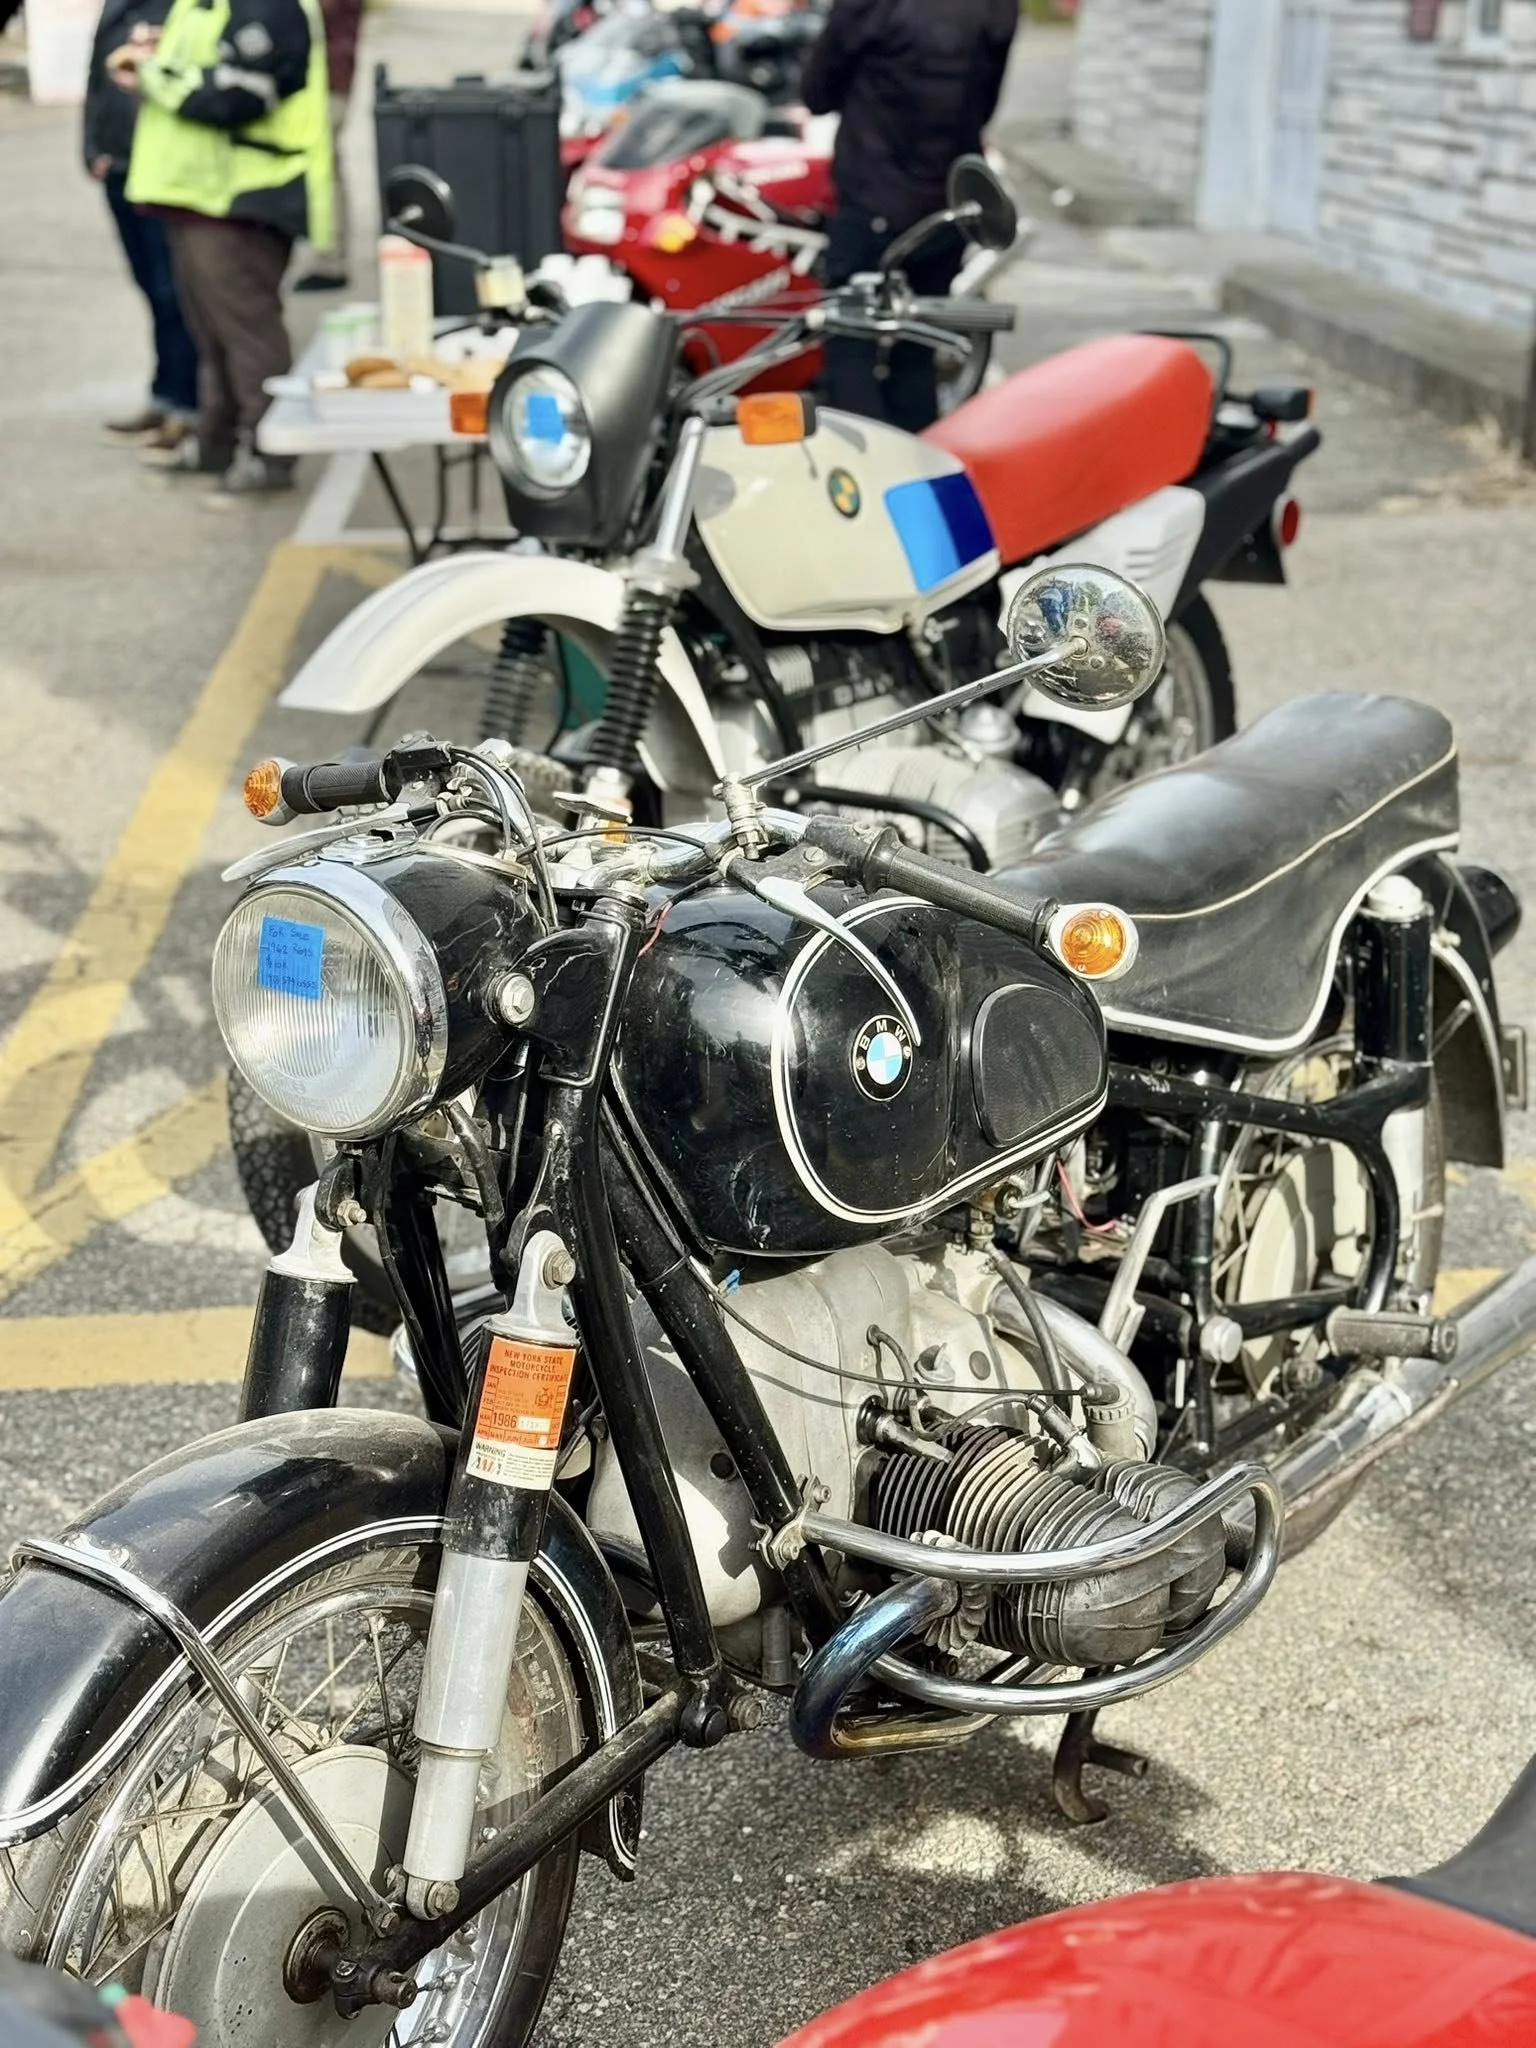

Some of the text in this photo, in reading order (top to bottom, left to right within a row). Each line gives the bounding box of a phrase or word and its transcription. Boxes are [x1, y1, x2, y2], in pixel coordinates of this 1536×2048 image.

[267, 941, 288, 955] 1962
[858, 1019, 907, 1051] BMW
[504, 1349, 564, 1365] NEW YORK STATE
[490, 1364, 530, 1379] INSPECTION
[510, 1359, 555, 1373] MOTORCYCLE
[493, 1412, 518, 1429] 1986
[475, 1441, 507, 1457] WARNING
